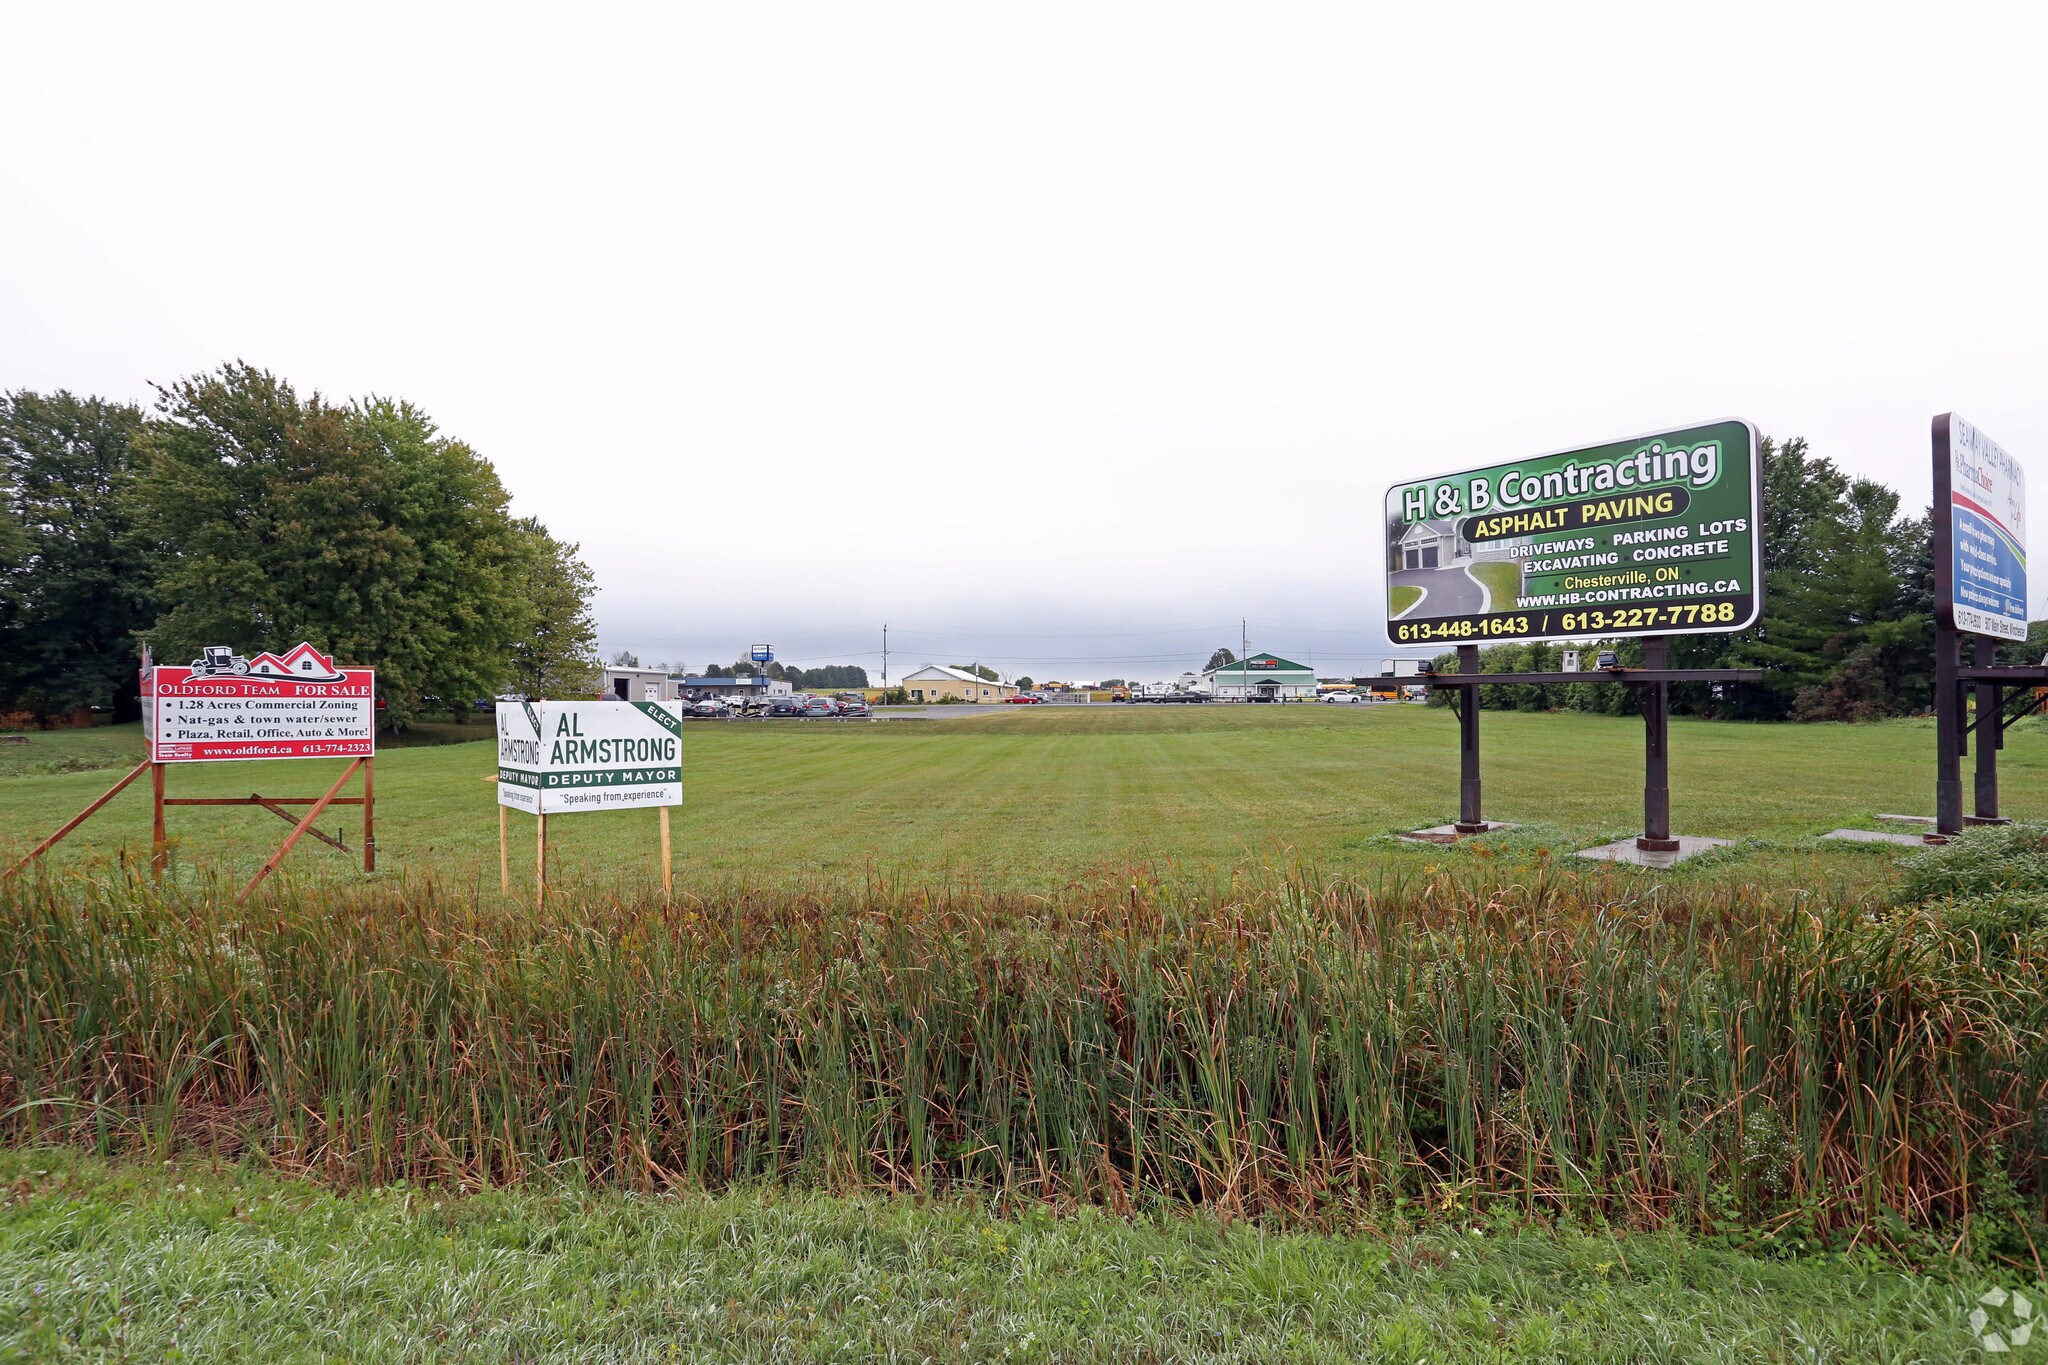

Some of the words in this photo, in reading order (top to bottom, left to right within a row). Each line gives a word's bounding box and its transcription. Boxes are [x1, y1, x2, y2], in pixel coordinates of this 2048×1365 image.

[1959, 421, 1981, 455] SEAWAY
[1982, 439, 1999, 468] VALLEY
[2000, 452, 2021, 486] PHARMACY
[1405, 490, 1425, 520] H
[1435, 484, 1462, 515] &
[1470, 479, 1490, 510] B
[1500, 444, 1718, 504] Contracting
[1475, 508, 1568, 538] ASPHALT
[1582, 492, 1674, 524] PAVING
[1510, 538, 1595, 559] DRIVEWAYS
[1613, 526, 1689, 546] PARKING
[1700, 518, 1747, 537] LOTS
[1524, 552, 1618, 573] EXCAVATING
[1633, 540, 1728, 561] CONCRETE
[1564, 570, 1651, 590] Chesterville,
[1655, 566, 1679, 583] ON
[1516, 579, 1740, 608] WWW.HB-CONTRACTING.CA
[1399, 617, 1529, 640] 613-448-1643
[1542, 614, 1549, 632] /
[1562, 602, 1735, 631] 613-227-7788
[159, 684, 237, 695] OLDFORD
[241, 684, 280, 695] TEAM
[295, 686, 327, 696] FOR
[331, 686, 370, 696] SALE
[178, 700, 204, 710] 1.28
[207, 700, 242, 710] Acres
[245, 700, 316, 710] Commercial
[319, 700, 358, 711] Zoning
[647, 705, 677, 729] ELECT
[178, 716, 229, 726] Nat-gas
[234, 715, 245, 724] &
[286, 714, 357, 724] water/sewer
[501, 713, 509, 736] AL
[527, 706, 539, 731] ELECT
[556, 712, 584, 737] AL
[178, 730, 213, 740] Plaza,
[216, 729, 254, 739] Retail,
[257, 729, 294, 738] Office,
[297, 728, 322, 737] Auto
[325, 728, 335, 736] &
[338, 728, 368, 736] More!
[204, 745, 292, 756] www.oldford.ca
[303, 744, 371, 753] 613-774-2323
[501, 738, 540, 765] ARMSTRONG
[550, 738, 676, 765] ARMSTRONG
[500, 770, 518, 782] DEPUTY
[520, 773, 538, 786] MAYOR
[549, 772, 615, 785] DEPUTY
[623, 770, 676, 782] MAYOR
[604, 792, 622, 802] from
